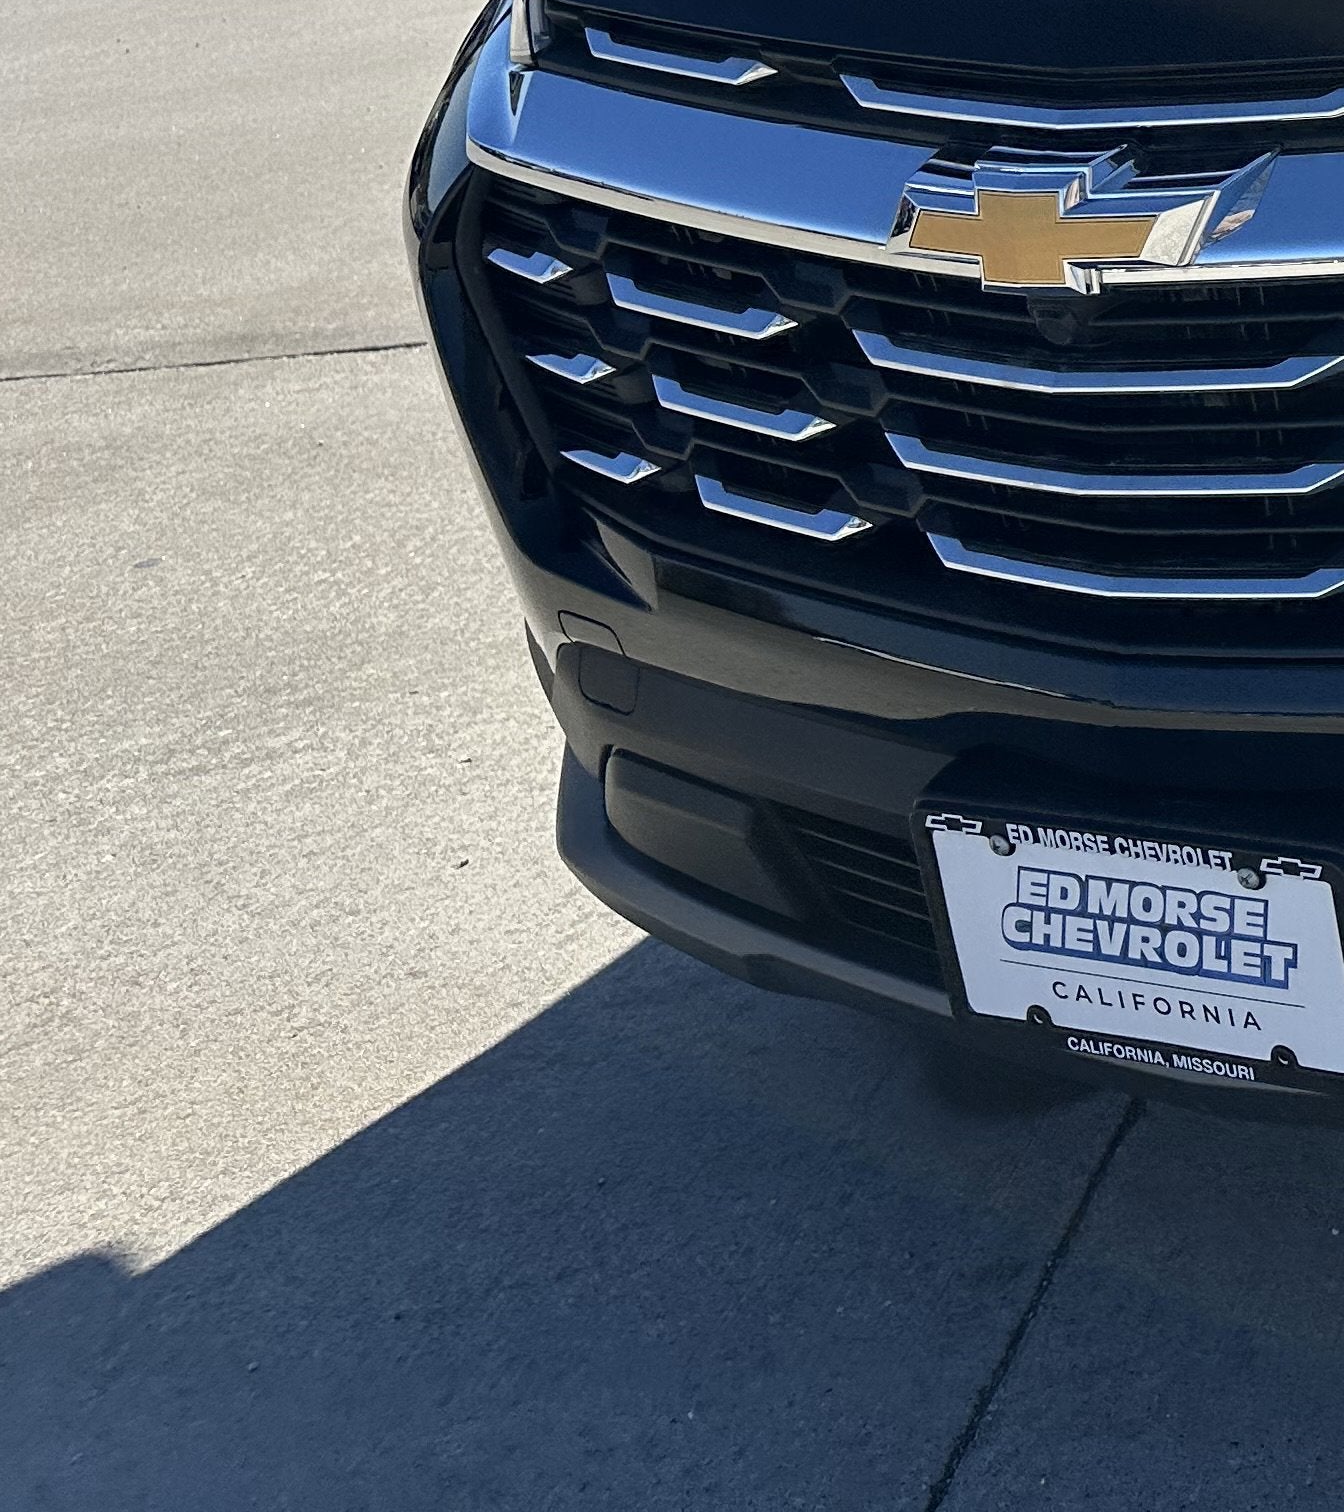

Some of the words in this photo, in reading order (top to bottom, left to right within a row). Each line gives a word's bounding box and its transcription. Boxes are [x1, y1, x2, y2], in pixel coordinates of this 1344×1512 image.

[1005, 822, 1035, 846] ED
[1037, 827, 1111, 856] MORSE
[1114, 836, 1234, 873] CHEVROLET
[1018, 868, 1081, 911] ED
[1086, 877, 1266, 938] MORSE
[1002, 903, 1295, 985] CHEVROLET
[1052, 981, 1262, 1031] CALIFORNIA
[1066, 1036, 1171, 1069] CALIFORNIA,
[1172, 1053, 1255, 1081] MISSOURI
